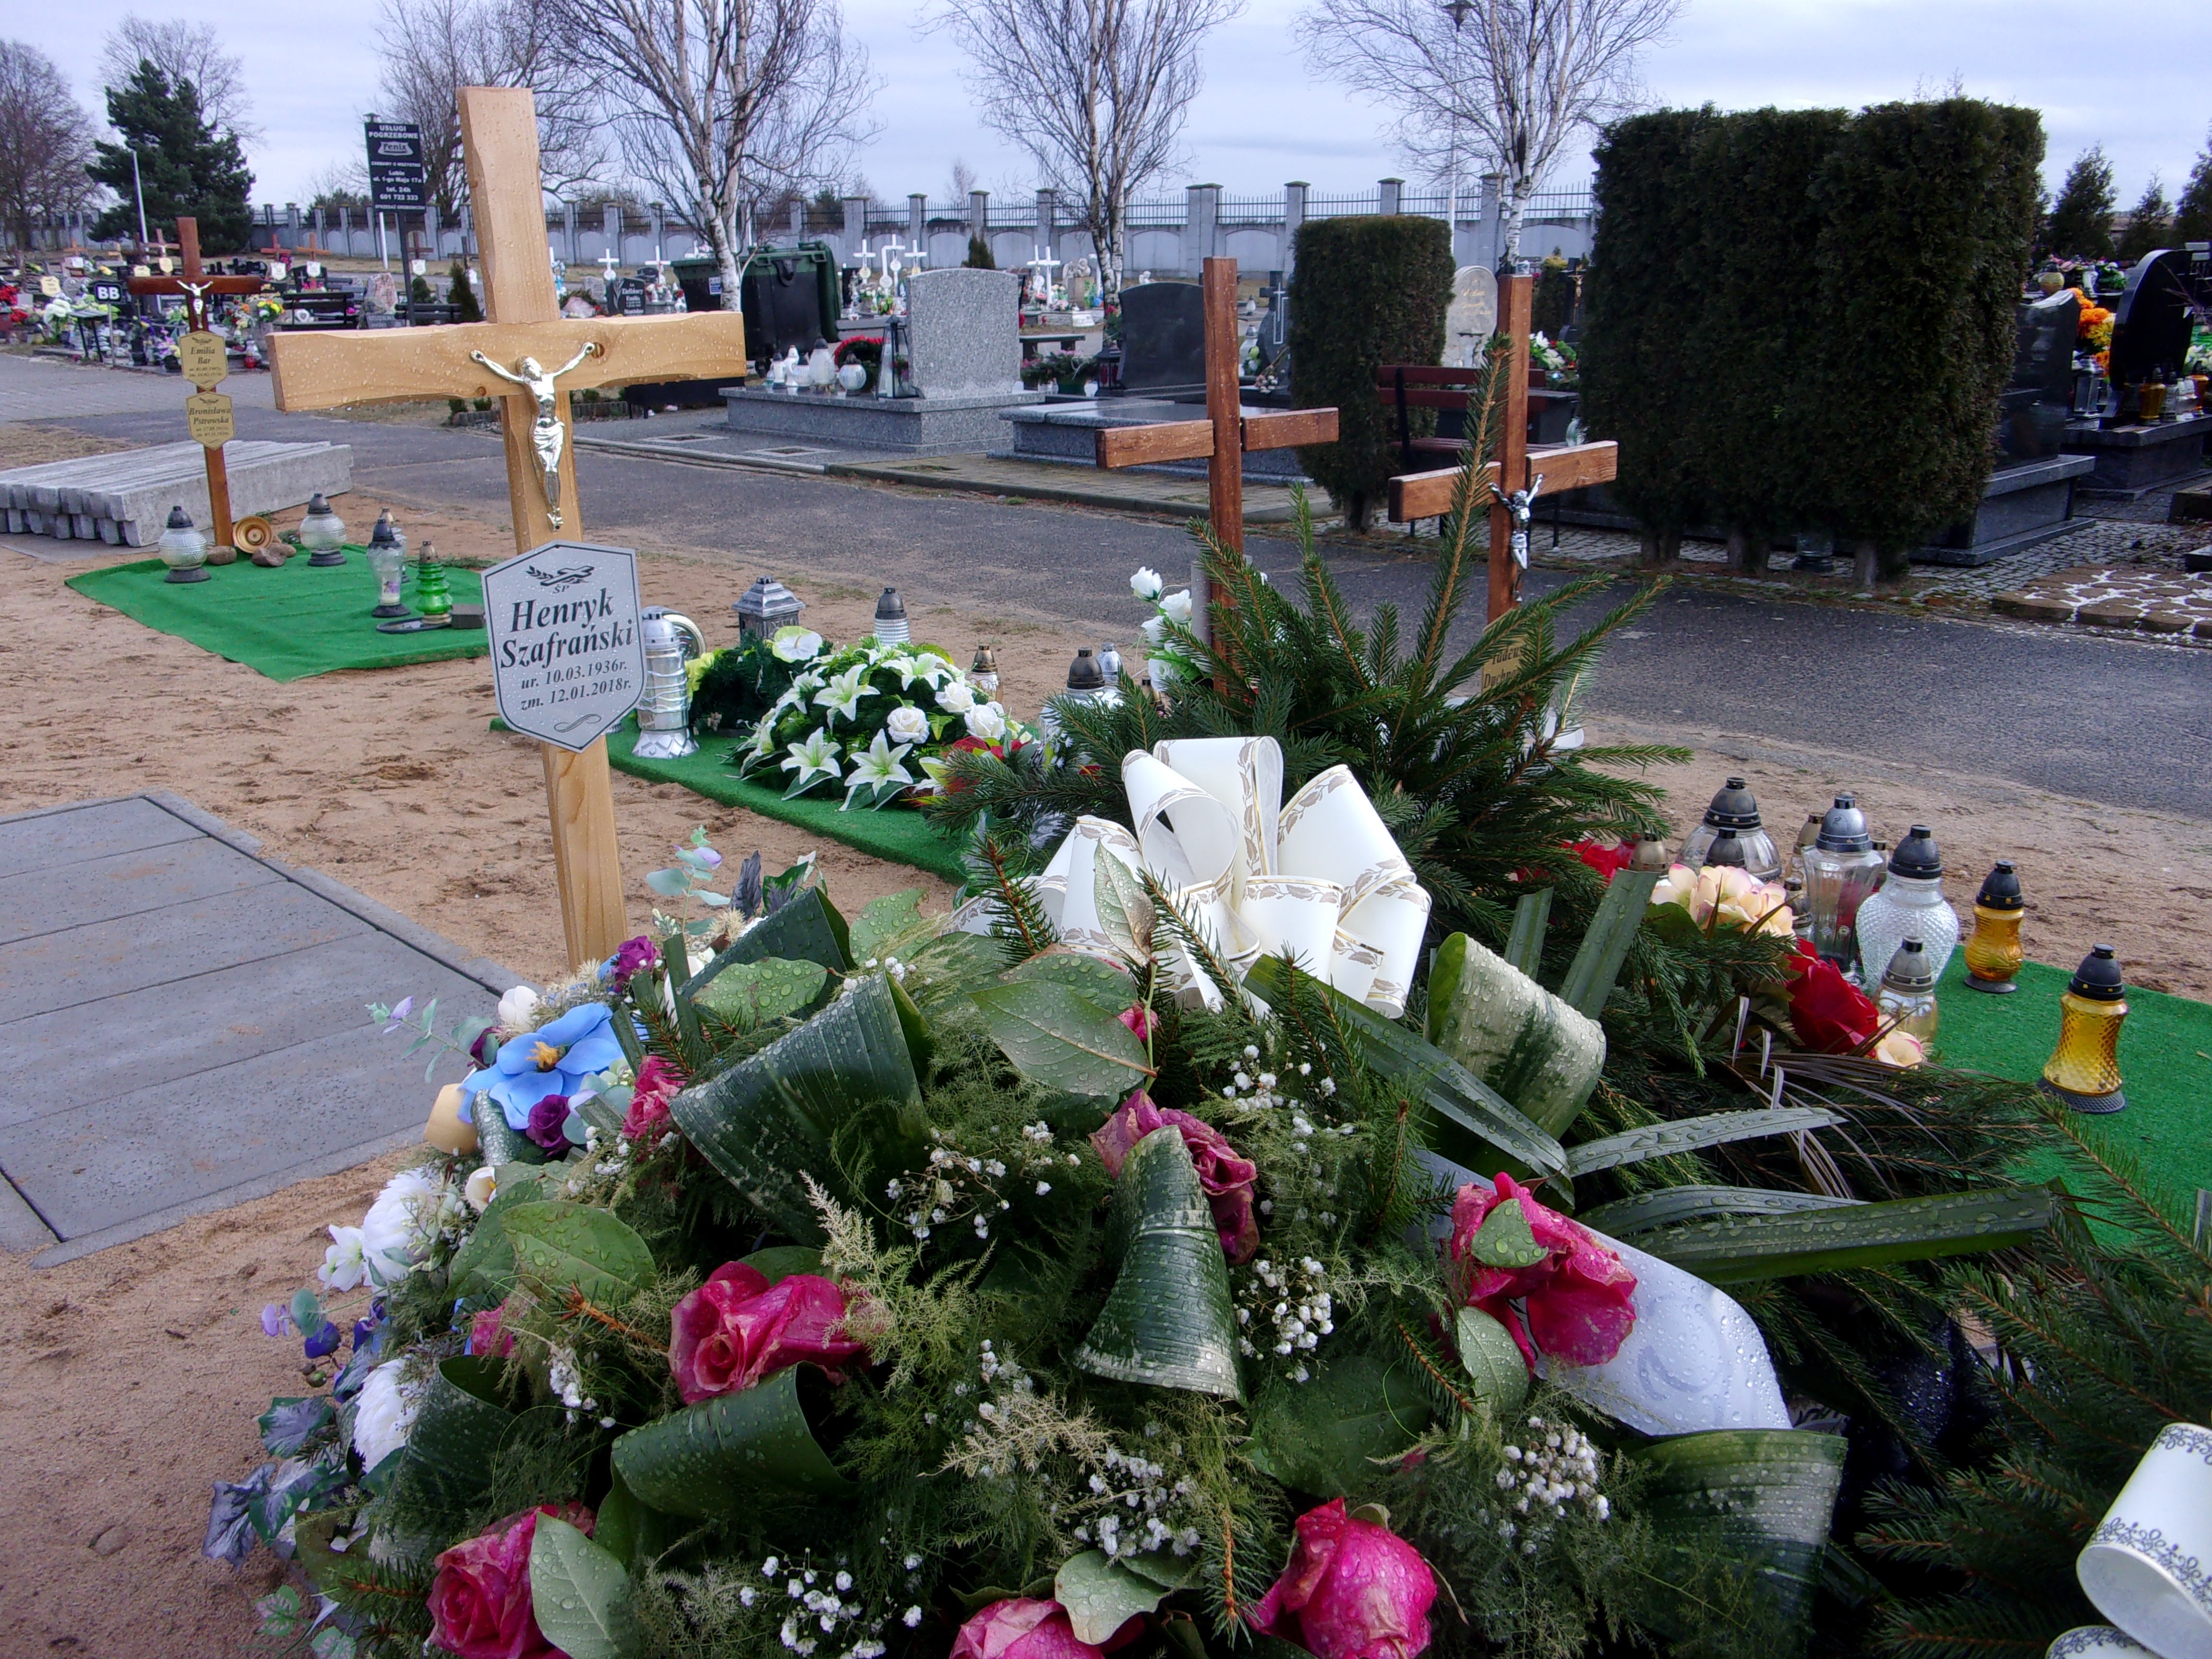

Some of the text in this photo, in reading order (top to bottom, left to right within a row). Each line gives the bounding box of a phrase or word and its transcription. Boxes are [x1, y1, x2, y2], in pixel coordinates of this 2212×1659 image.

[368, 131, 419, 139] POGRZEBOWE
[97, 286, 120, 300] BB
[191, 347, 216, 355] Emilia
[553, 584, 570, 594] ŚP
[509, 587, 614, 633] Henryk
[500, 619, 633, 669] Szafrański
[521, 659, 627, 689] ur. 10.03.1936r.
[521, 677, 632, 711] zm. 12.01.2018r.
